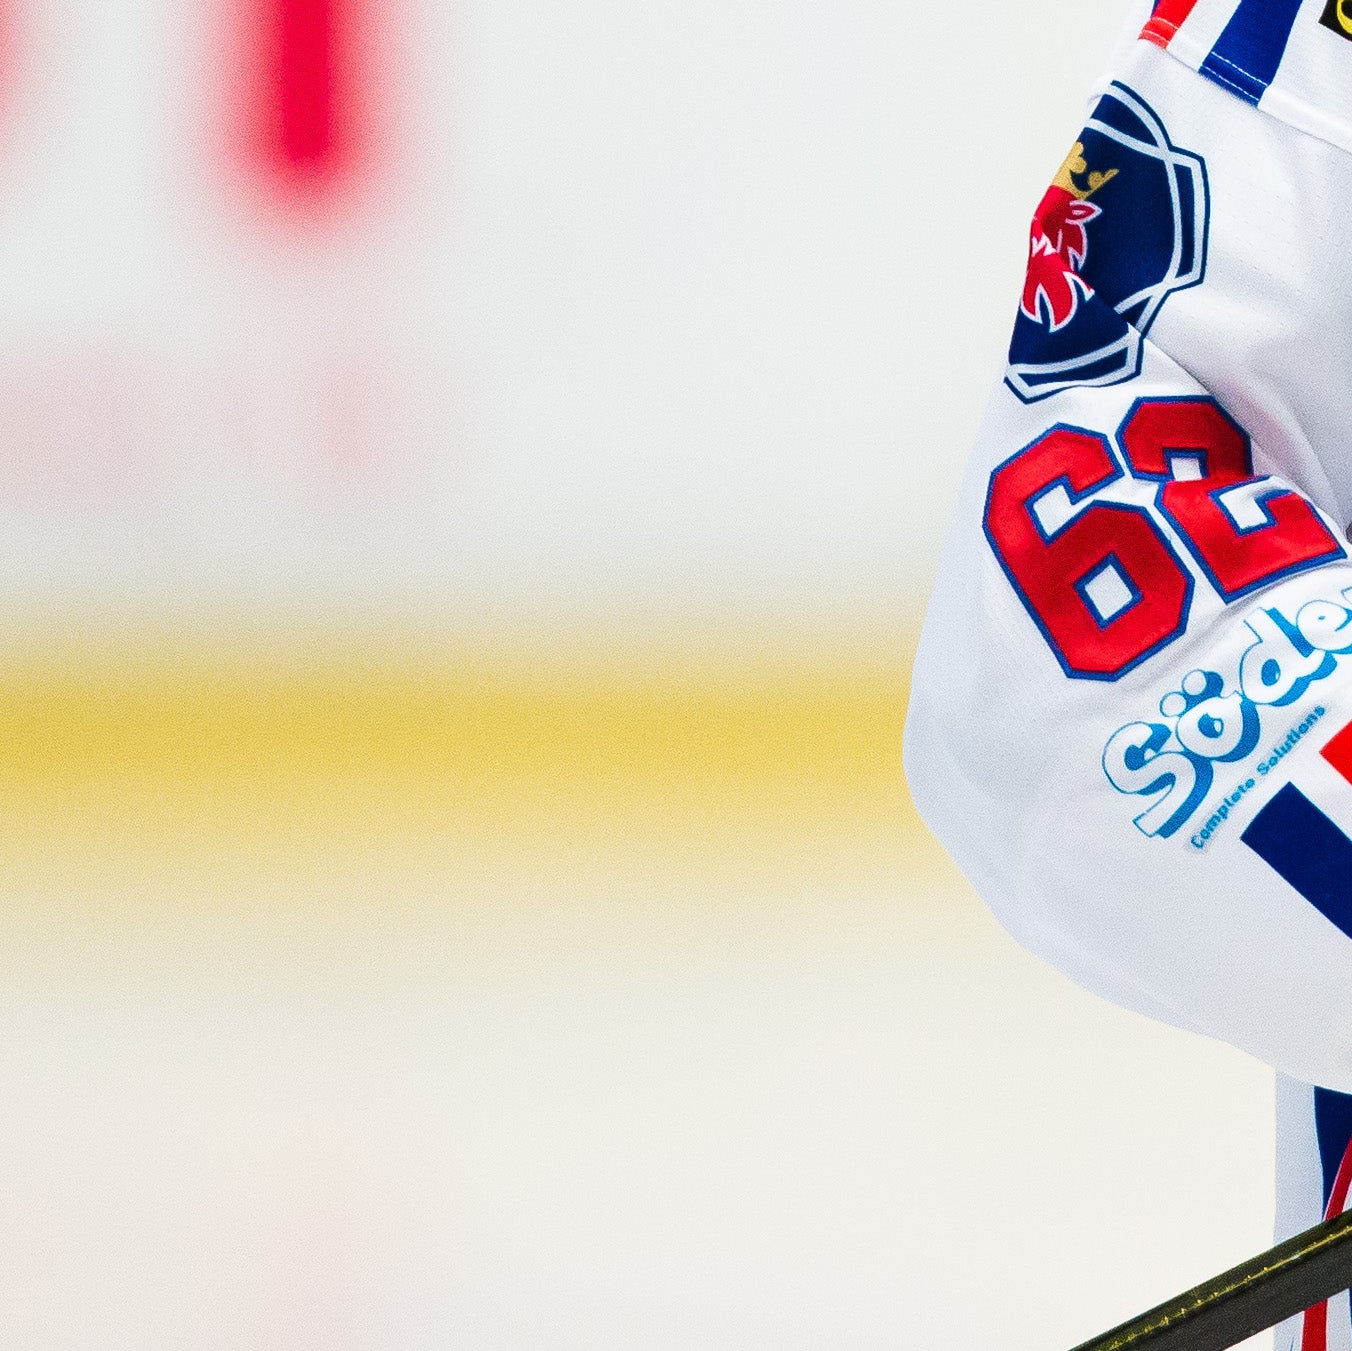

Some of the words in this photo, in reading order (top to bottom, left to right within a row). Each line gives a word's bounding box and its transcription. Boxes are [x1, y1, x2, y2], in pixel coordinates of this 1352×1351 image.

[983, 395, 1347, 682] 62
[1190, 777, 1256, 849] Complete
[1257, 706, 1325, 775] Solutions
